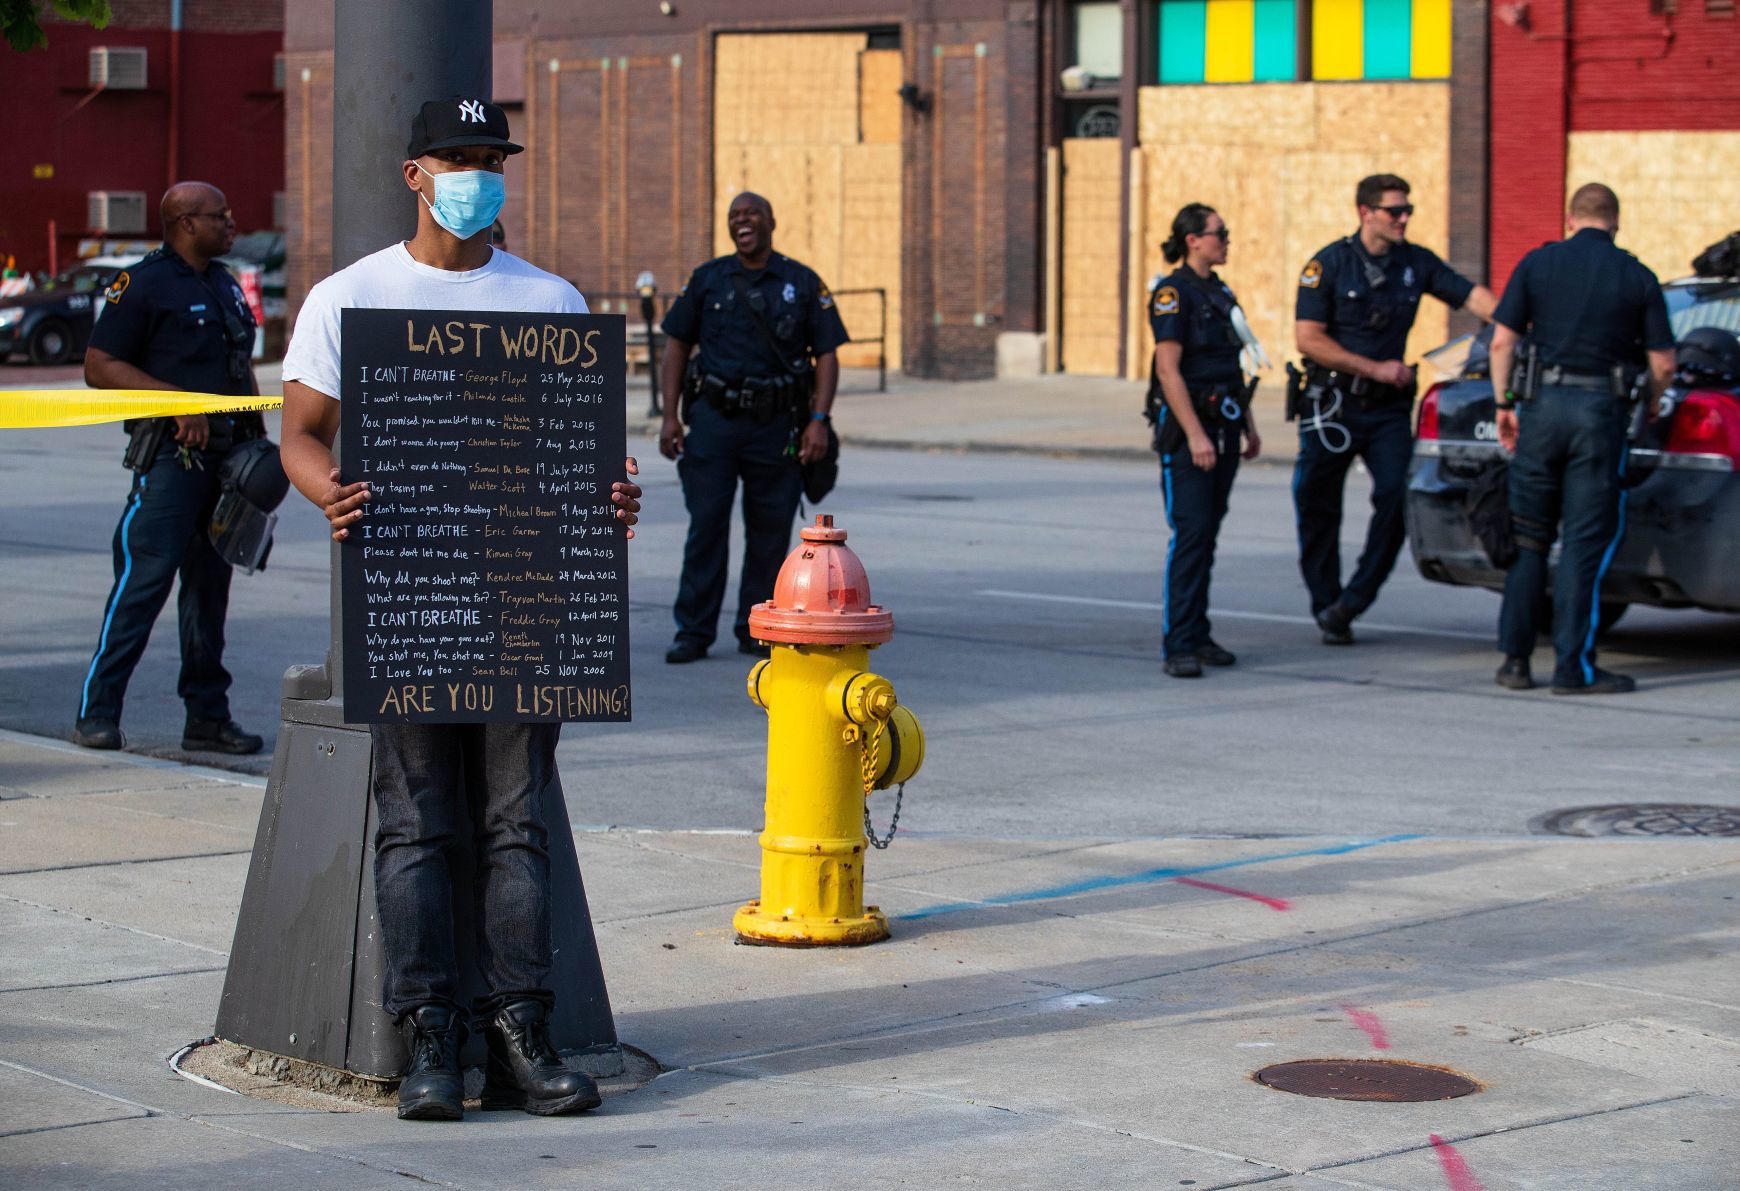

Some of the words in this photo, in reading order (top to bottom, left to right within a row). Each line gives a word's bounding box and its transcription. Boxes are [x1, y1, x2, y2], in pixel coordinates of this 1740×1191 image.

[407, 320, 491, 358] LAST
[501, 324, 601, 368] WORDS
[360, 366, 369, 383] I
[413, 368, 455, 382] BREATHE
[465, 370, 498, 385] George
[502, 371, 528, 387] Floyd
[540, 374, 553, 383] 25
[557, 372, 573, 388] May
[576, 374, 604, 385] 2020
[361, 392, 369, 404] I
[404, 394, 431, 405] reaching
[445, 391, 452, 401] it
[541, 394, 547, 402] 6
[554, 393, 572, 407] July
[576, 393, 603, 403] 2016
[361, 413, 381, 428] You
[386, 415, 420, 432] promised
[422, 418, 435, 428] you
[503, 414, 530, 423] Natasha
[538, 418, 545, 428] 3
[549, 419, 565, 430] Feb
[572, 420, 595, 431] 2015
[362, 436, 369, 447] I
[374, 436, 397, 447] don't
[426, 437, 438, 446] die
[500, 438, 521, 449] Taylor
[536, 439, 542, 448] 7
[546, 440, 562, 453] Aug
[569, 440, 596, 451] 2015
[362, 459, 370, 472] I
[431, 461, 439, 470] do
[536, 462, 545, 475] 19
[550, 464, 570, 479] July
[572, 463, 595, 475] 2015
[420, 485, 435, 493] me
[469, 481, 498, 491] Walter
[500, 481, 526, 493] Scott
[539, 481, 546, 493] 4
[550, 482, 570, 496] April
[574, 481, 597, 494] 2015
[363, 503, 371, 515] I
[374, 503, 396, 514] don't
[399, 503, 417, 513] have
[443, 503, 461, 516] Stop
[463, 504, 491, 520] Shooting
[561, 503, 568, 517] 9
[572, 504, 588, 521] Aug
[592, 504, 617, 518] 2014
[362, 525, 372, 538] I
[417, 524, 469, 537] BREATHE
[485, 525, 506, 537] Eric
[559, 525, 568, 534] 17
[570, 525, 587, 539] July
[591, 526, 614, 536] 2014
[364, 546, 395, 559] Please
[422, 548, 434, 557] let
[437, 550, 449, 559] me
[453, 549, 469, 559] die
[485, 547, 513, 559] Kimani
[515, 548, 533, 561] Gray
[560, 547, 566, 559] 9
[571, 547, 592, 557] March
[594, 548, 614, 559] 2013
[364, 568, 391, 588] Why
[395, 570, 411, 585] did
[415, 575, 430, 587] you
[432, 571, 457, 585] shoot
[525, 571, 555, 582] McDade
[559, 571, 570, 581] 24
[573, 570, 596, 582] March
[597, 571, 617, 580] 2012
[367, 591, 393, 604] What
[414, 595, 429, 606] you
[431, 592, 459, 606] following
[461, 595, 471, 603] me
[537, 592, 566, 605] Martin
[569, 592, 581, 602] 26
[584, 592, 598, 603] Feb
[600, 592, 619, 603] 2012
[367, 612, 377, 627] I
[420, 609, 481, 627] BREATHE
[500, 611, 535, 626] Freddie
[538, 614, 561, 629] Gray
[581, 611, 597, 622] April
[600, 611, 619, 621] 2015
[366, 632, 388, 649] Why
[390, 634, 400, 645] do
[401, 638, 417, 648] you
[418, 634, 436, 644] have
[439, 636, 455, 645] your
[555, 633, 565, 644] 19
[571, 633, 592, 646] Nov
[597, 633, 615, 644] 2011
[368, 650, 385, 662] You
[388, 648, 408, 661] shot
[433, 649, 449, 660] You
[451, 650, 471, 661] shot
[500, 652, 520, 661] Oscar
[571, 649, 586, 660] Jan
[592, 650, 614, 661] 2009
[370, 666, 378, 679] I
[386, 666, 412, 678] Love
[417, 665, 433, 678] You
[437, 665, 452, 675] too
[472, 666, 495, 676] Sean
[500, 666, 518, 676] Bell
[534, 665, 550, 675] 25
[583, 666, 606, 675] 2006
[379, 685, 436, 715] ARE
[447, 683, 494, 712] YOU
[516, 683, 629, 719] LISTENING?
